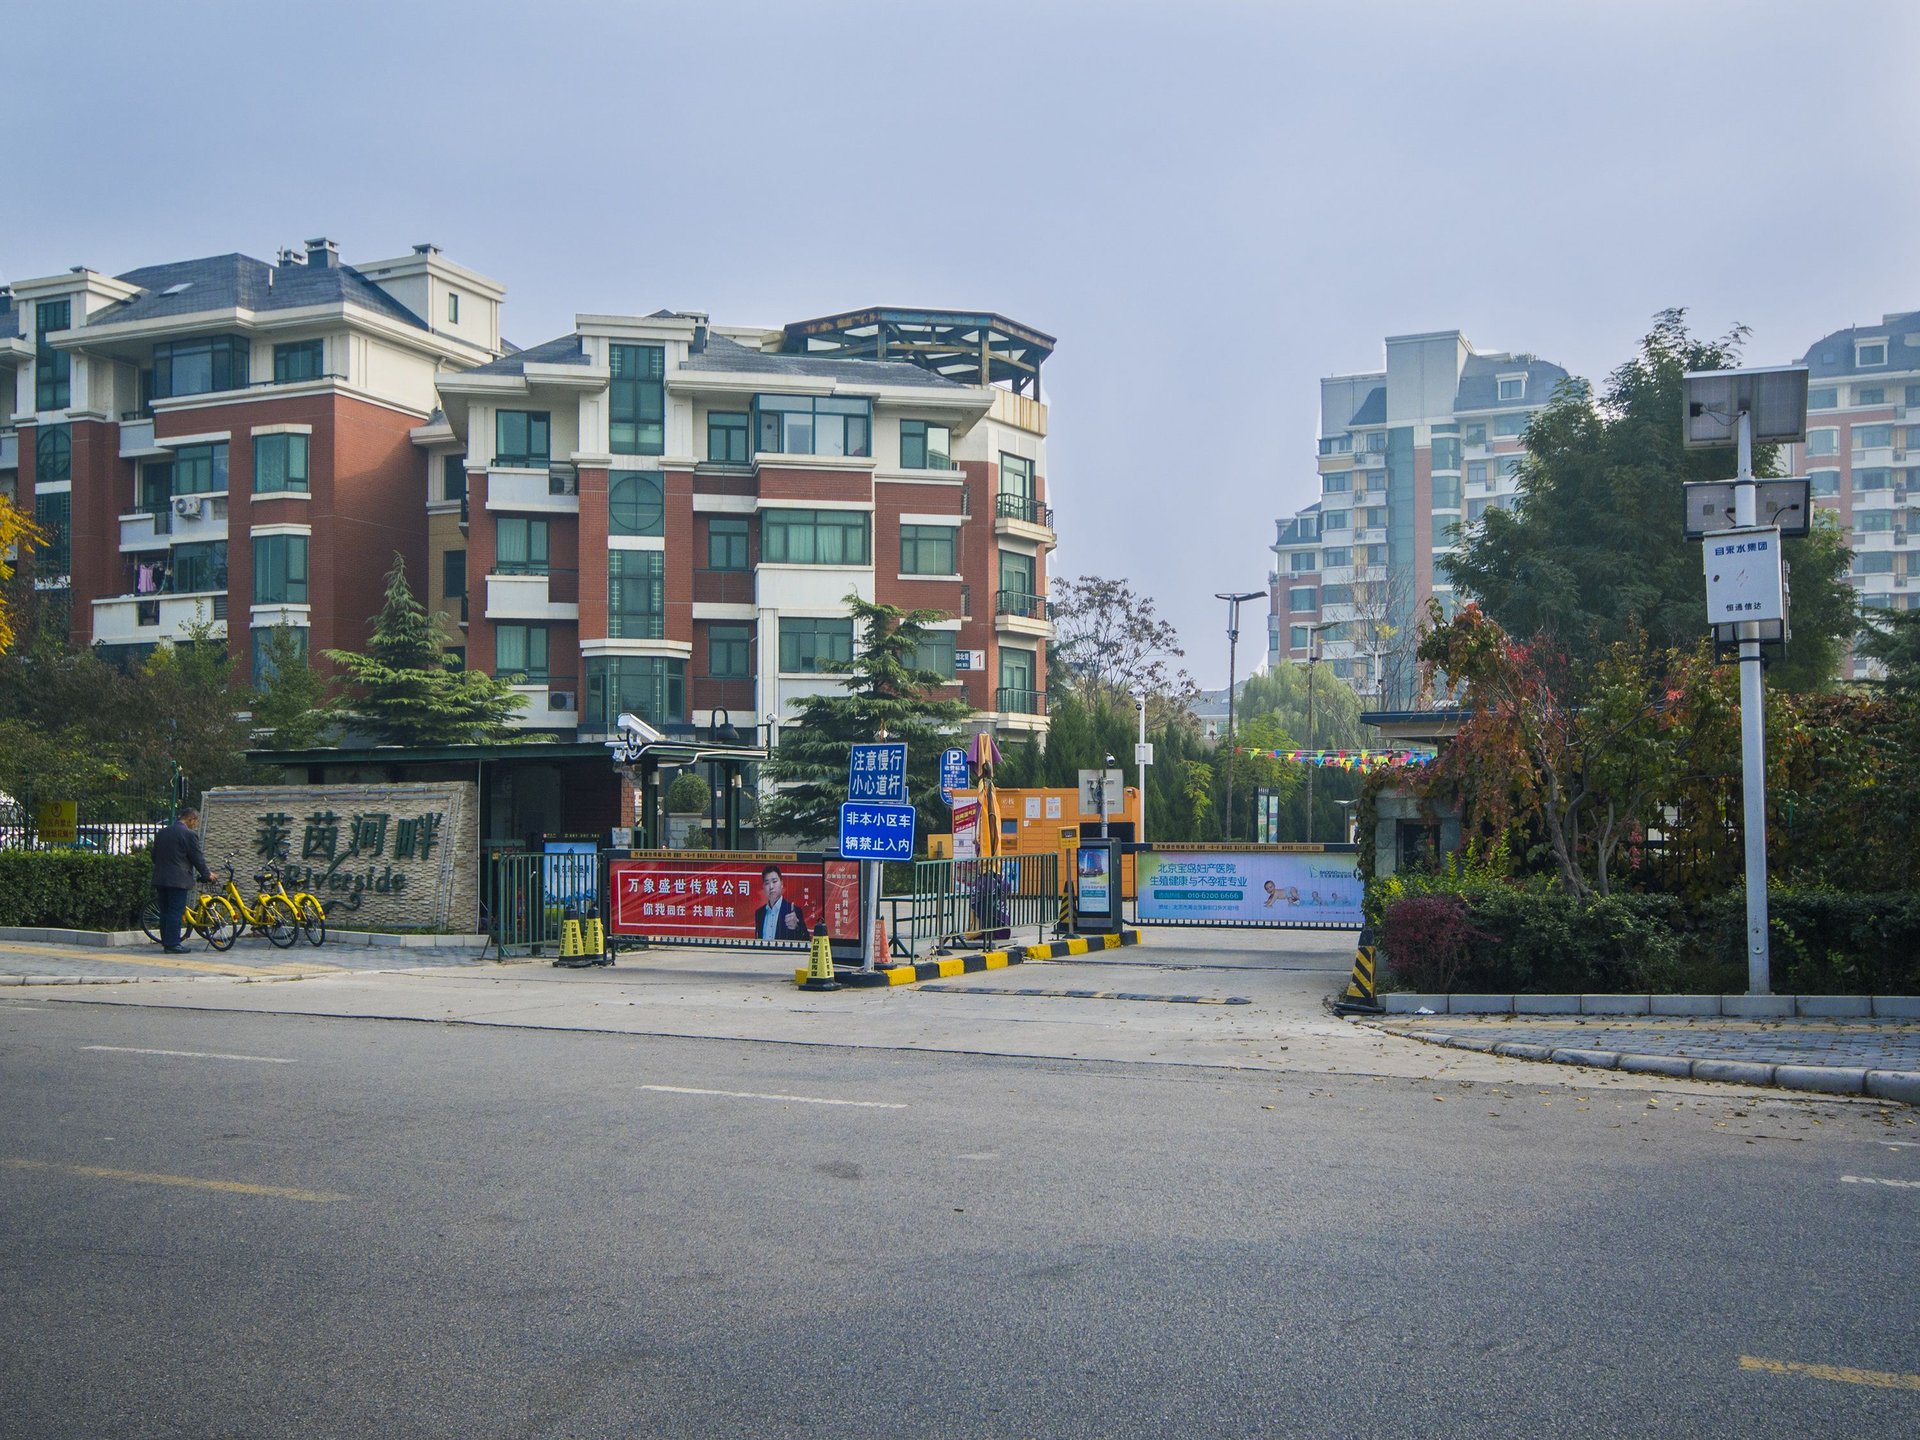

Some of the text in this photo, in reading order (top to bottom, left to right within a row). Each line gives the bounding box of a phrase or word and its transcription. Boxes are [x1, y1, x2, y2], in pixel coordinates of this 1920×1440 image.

[1715, 541, 1768, 556] 自来水集团
[1726, 602, 1762, 612] 恒通信达
[854, 750, 902, 771] 注意慢行
[852, 774, 901, 795] 小心道杆
[847, 812, 911, 828] 非本小区车
[253, 810, 444, 861] 莱茵河畔
[845, 836, 910, 852] 辆禁止入内
[1158, 863, 1237, 874] 北京宝岛妇产医院
[284, 864, 406, 892] Riverside
[1149, 876, 1248, 887] 生殖健康与不孕症专业
[628, 878, 750, 896] 万象盛世传媒公司
[643, 903, 735, 918] 你我同在 共赢未来
